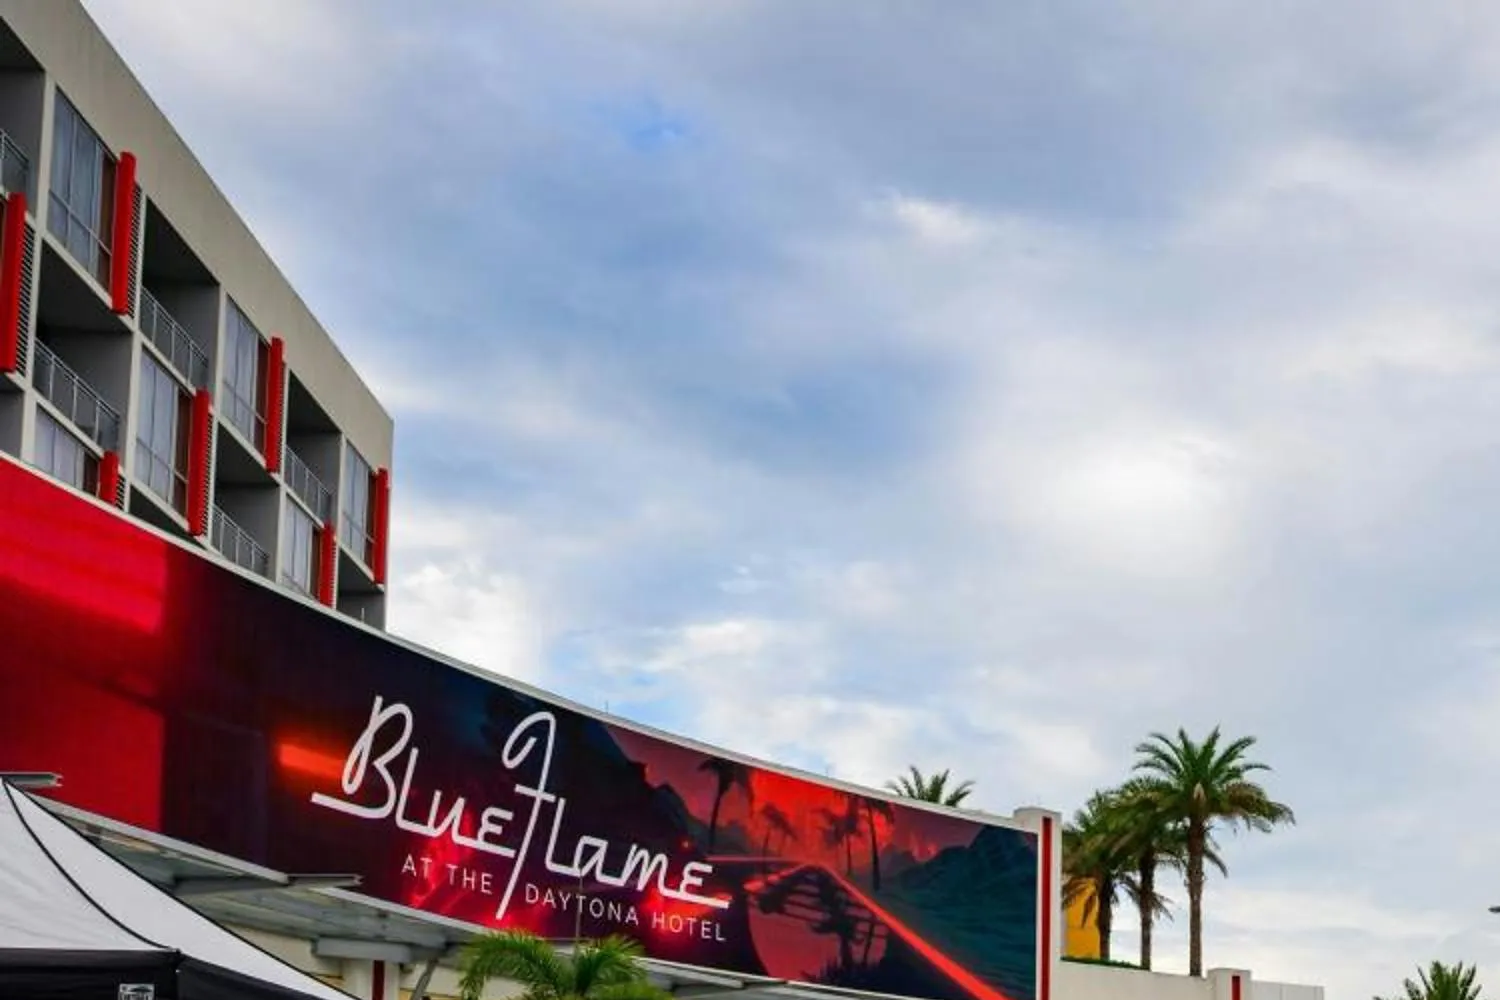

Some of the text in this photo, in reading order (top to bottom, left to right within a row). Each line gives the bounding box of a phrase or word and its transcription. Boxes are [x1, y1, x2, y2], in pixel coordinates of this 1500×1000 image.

[402, 853, 726, 942] AT THE DAYTONA HOTEL
